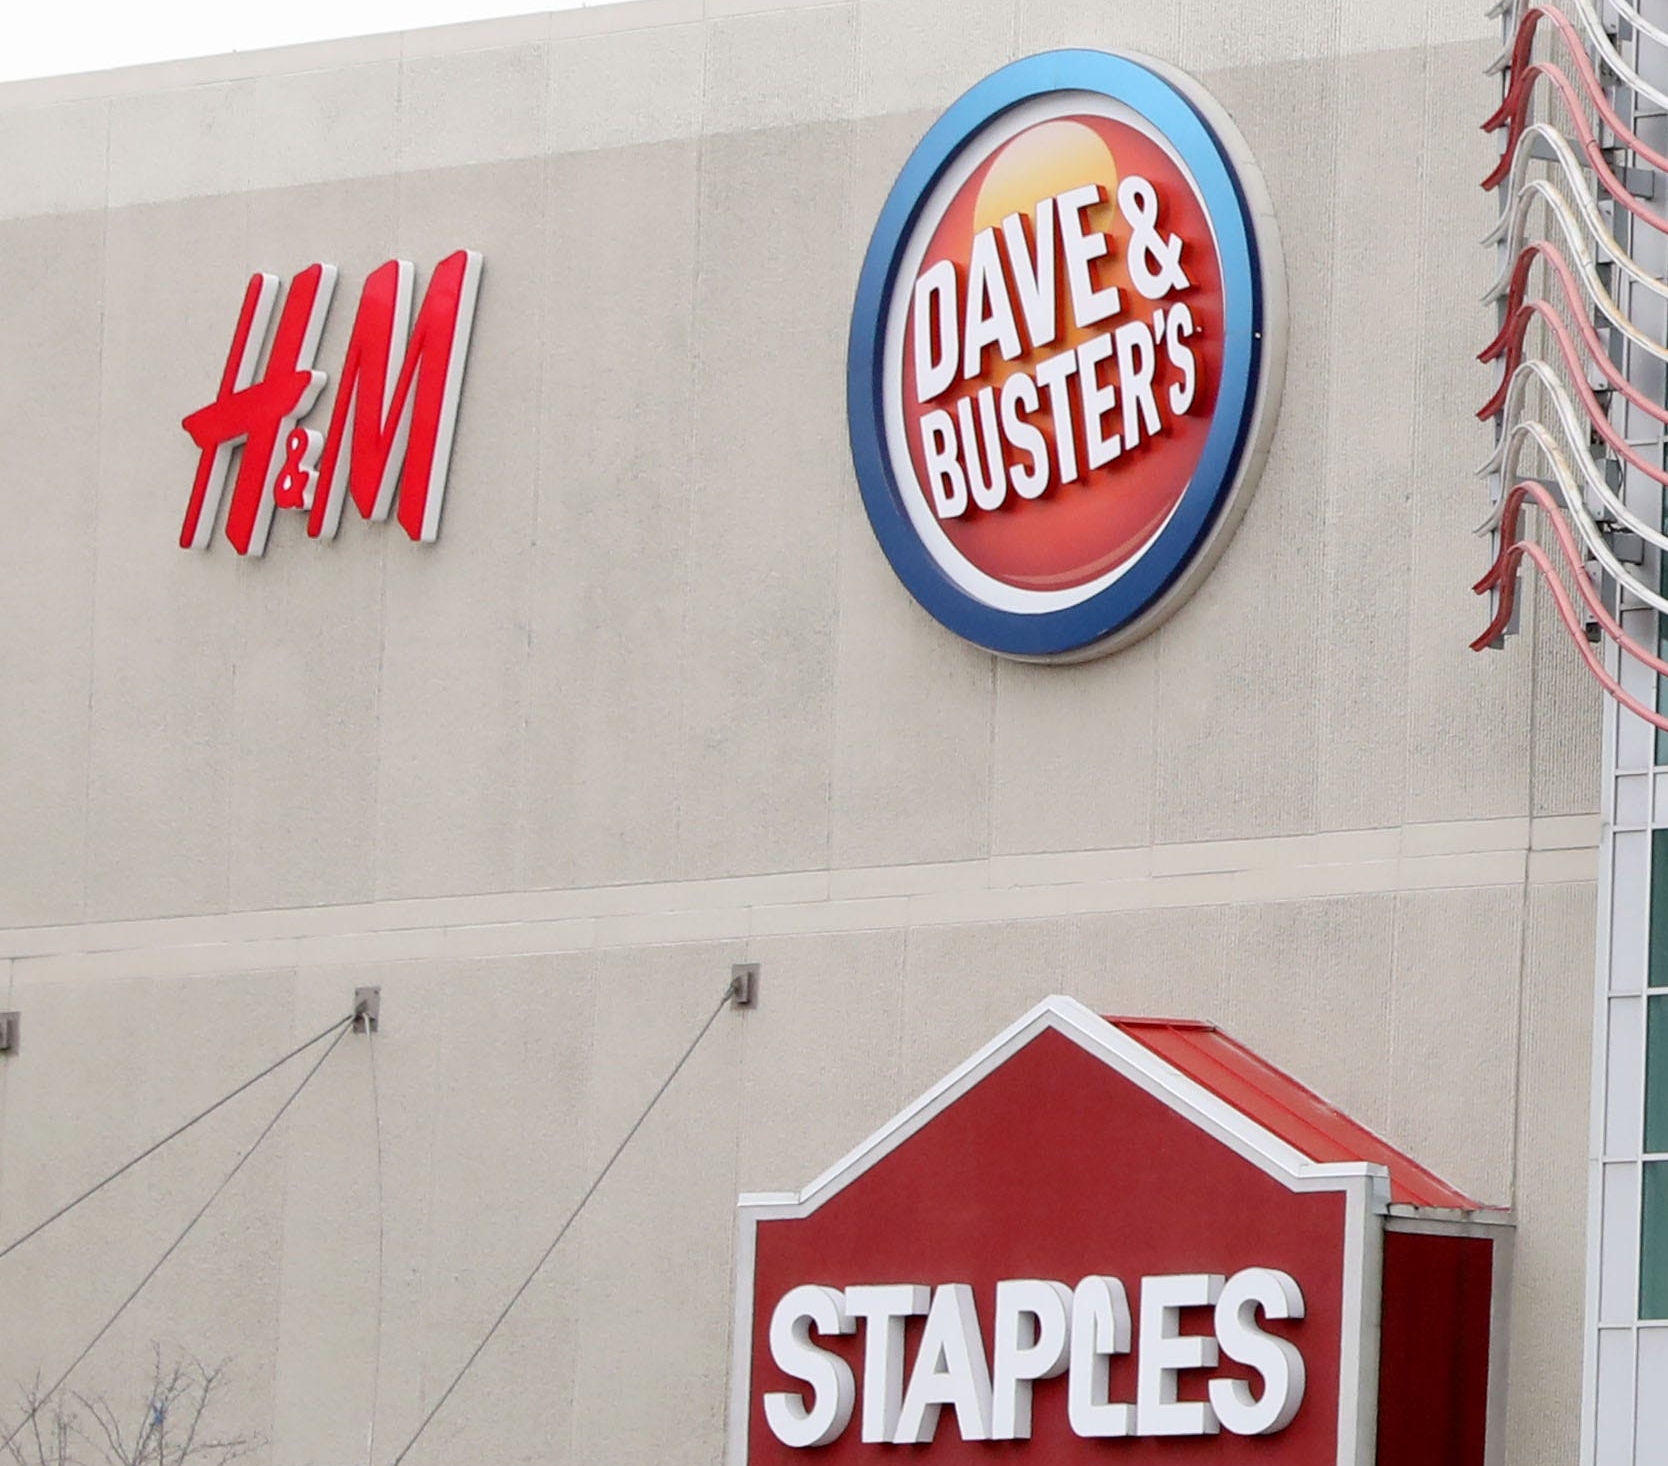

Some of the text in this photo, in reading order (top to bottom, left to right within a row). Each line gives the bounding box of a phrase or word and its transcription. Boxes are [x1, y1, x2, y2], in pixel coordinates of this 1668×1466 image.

[914, 175, 1190, 405] DAVE &
[179, 248, 484, 557] H&M
[919, 302, 1197, 519] BUSTER'S
[763, 1266, 1307, 1447] STAPLES
